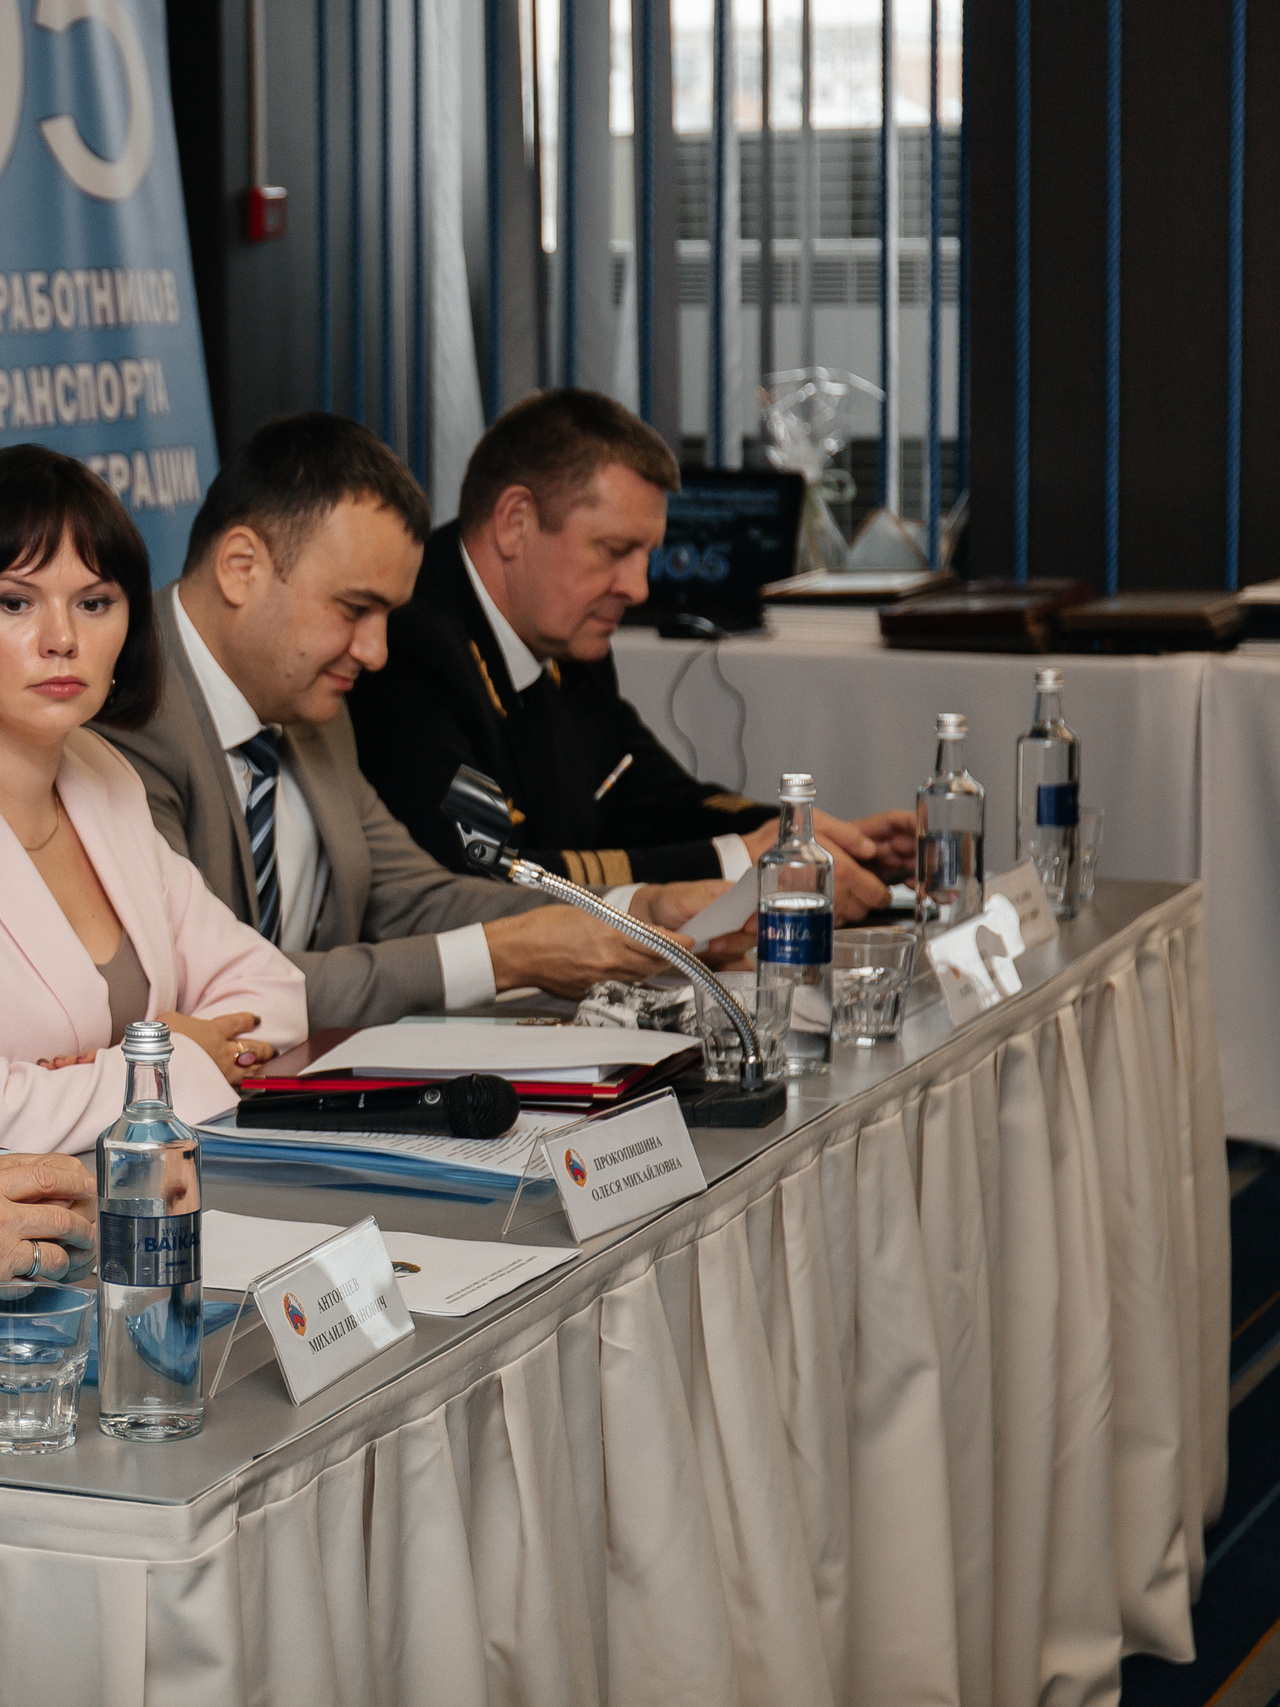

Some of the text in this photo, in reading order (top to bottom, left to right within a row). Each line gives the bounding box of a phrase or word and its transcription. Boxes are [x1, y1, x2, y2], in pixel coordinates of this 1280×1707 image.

[593, 1135, 663, 1171] ПРОКОПИШИНА
[591, 1156, 683, 1201] ОЛЕСЯ МИХАЙЛОВНА
[144, 1232, 200, 1252] BAIKA
[317, 1277, 360, 1314] АНТОНЦЕВ
[308, 1295, 388, 1355] МИХАИЛ ИВАНОВИЧ
